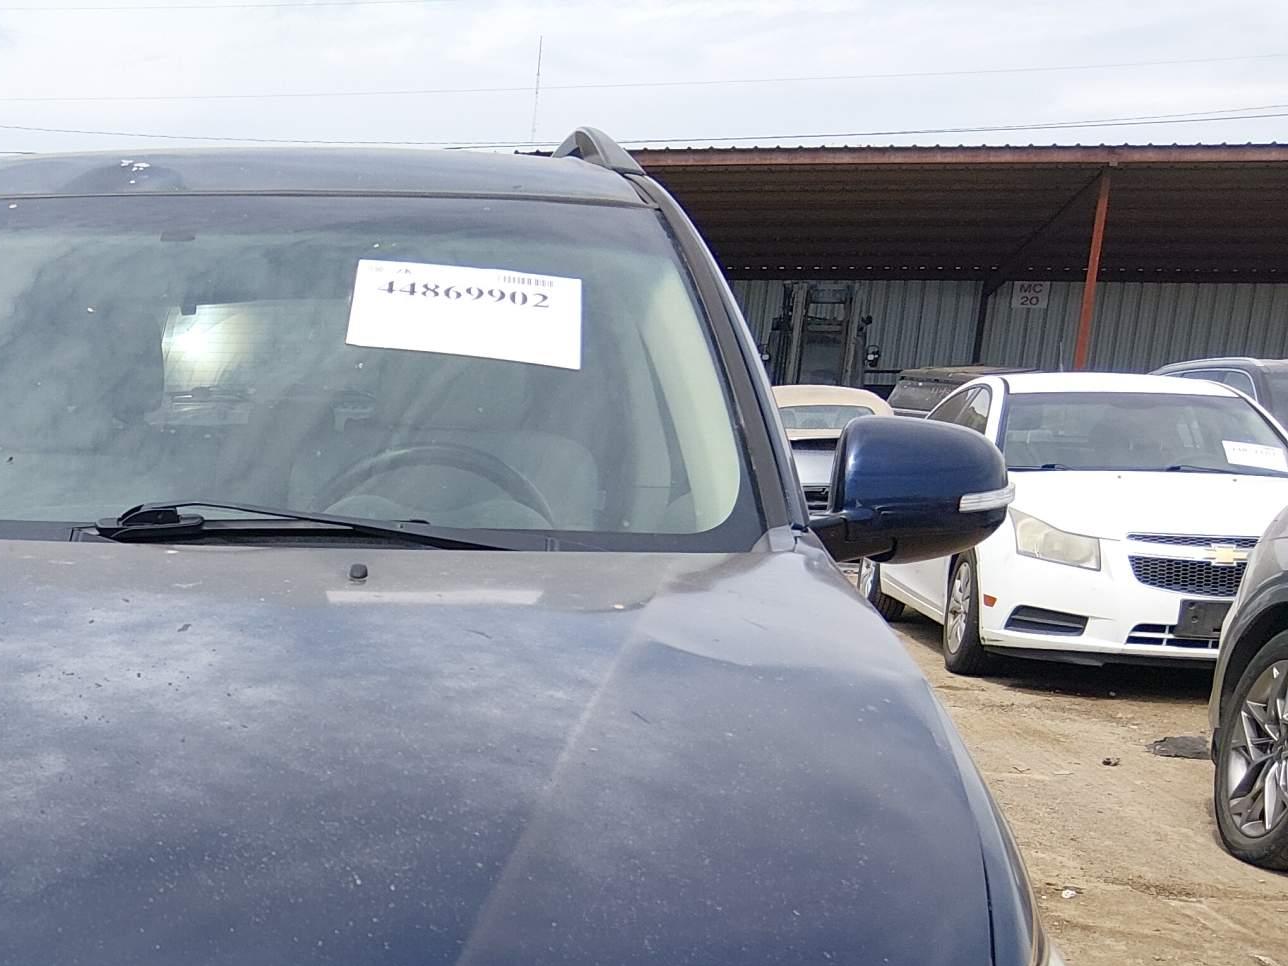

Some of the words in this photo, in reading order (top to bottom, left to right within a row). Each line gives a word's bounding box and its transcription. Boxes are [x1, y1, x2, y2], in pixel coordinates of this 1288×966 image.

[376, 279, 550, 309] 44869902
[1019, 283, 1044, 295] MC
[1020, 296, 1040, 306] 20
